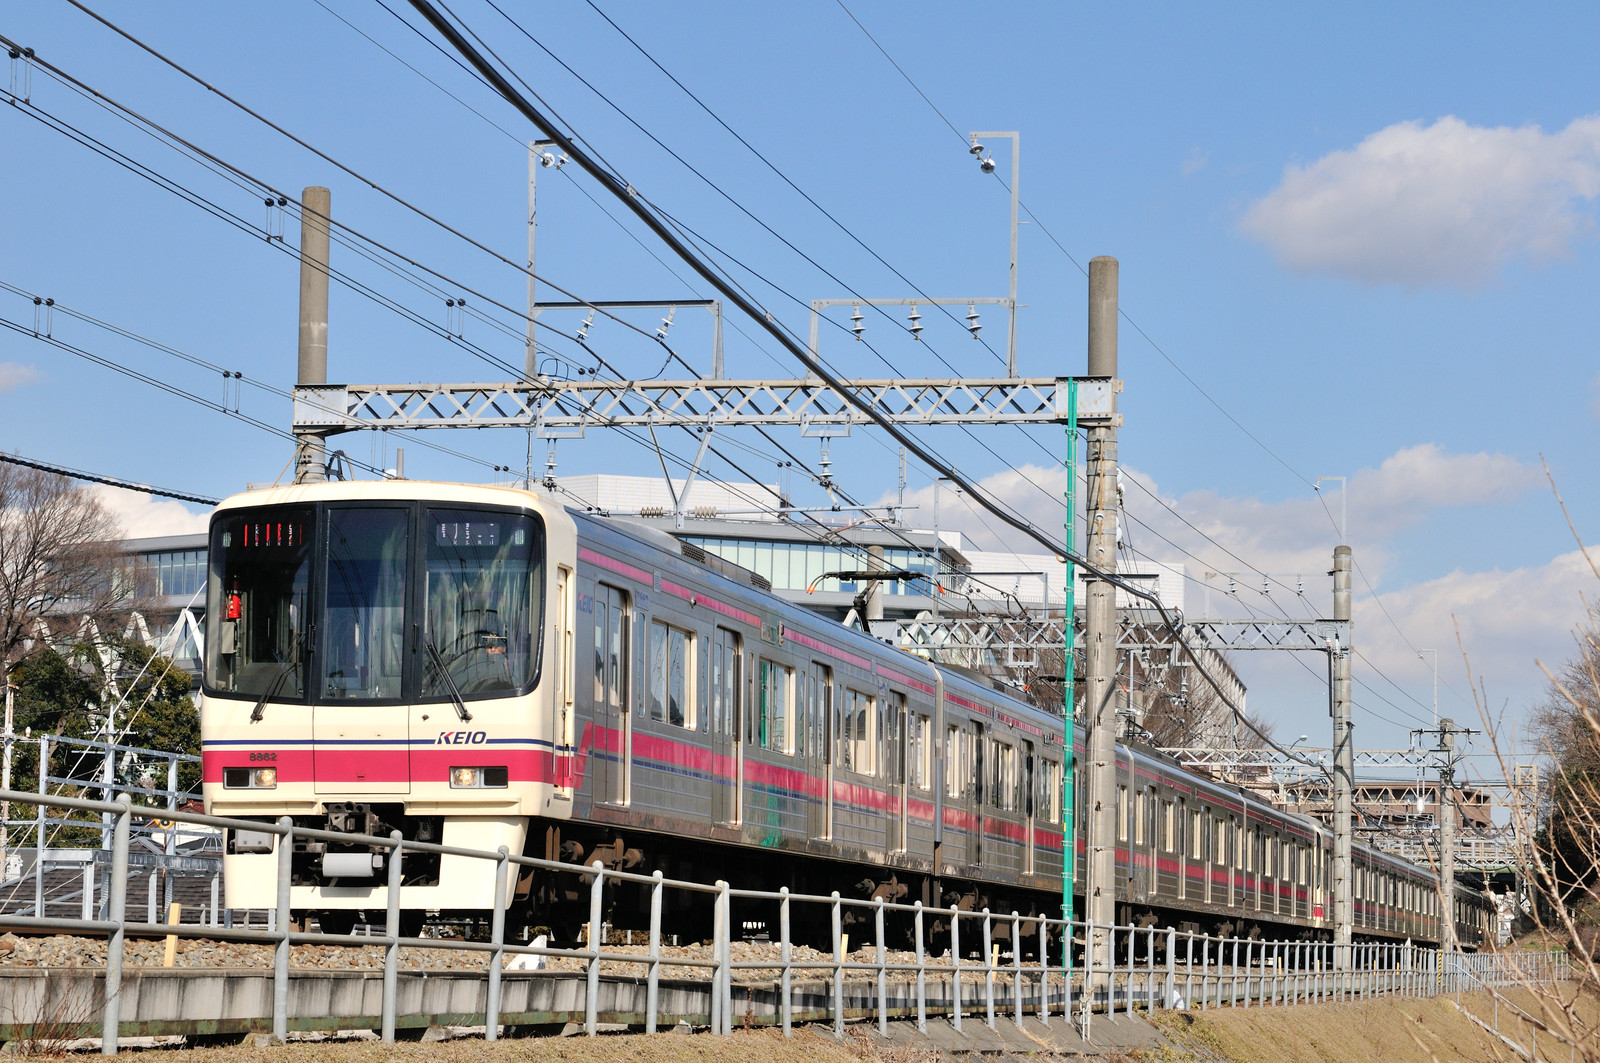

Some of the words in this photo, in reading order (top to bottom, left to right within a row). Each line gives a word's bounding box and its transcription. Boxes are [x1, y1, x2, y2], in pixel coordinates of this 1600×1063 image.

[576, 592, 594, 615] KEIO
[437, 731, 487, 744] KEIO
[250, 752, 278, 762] 8862
